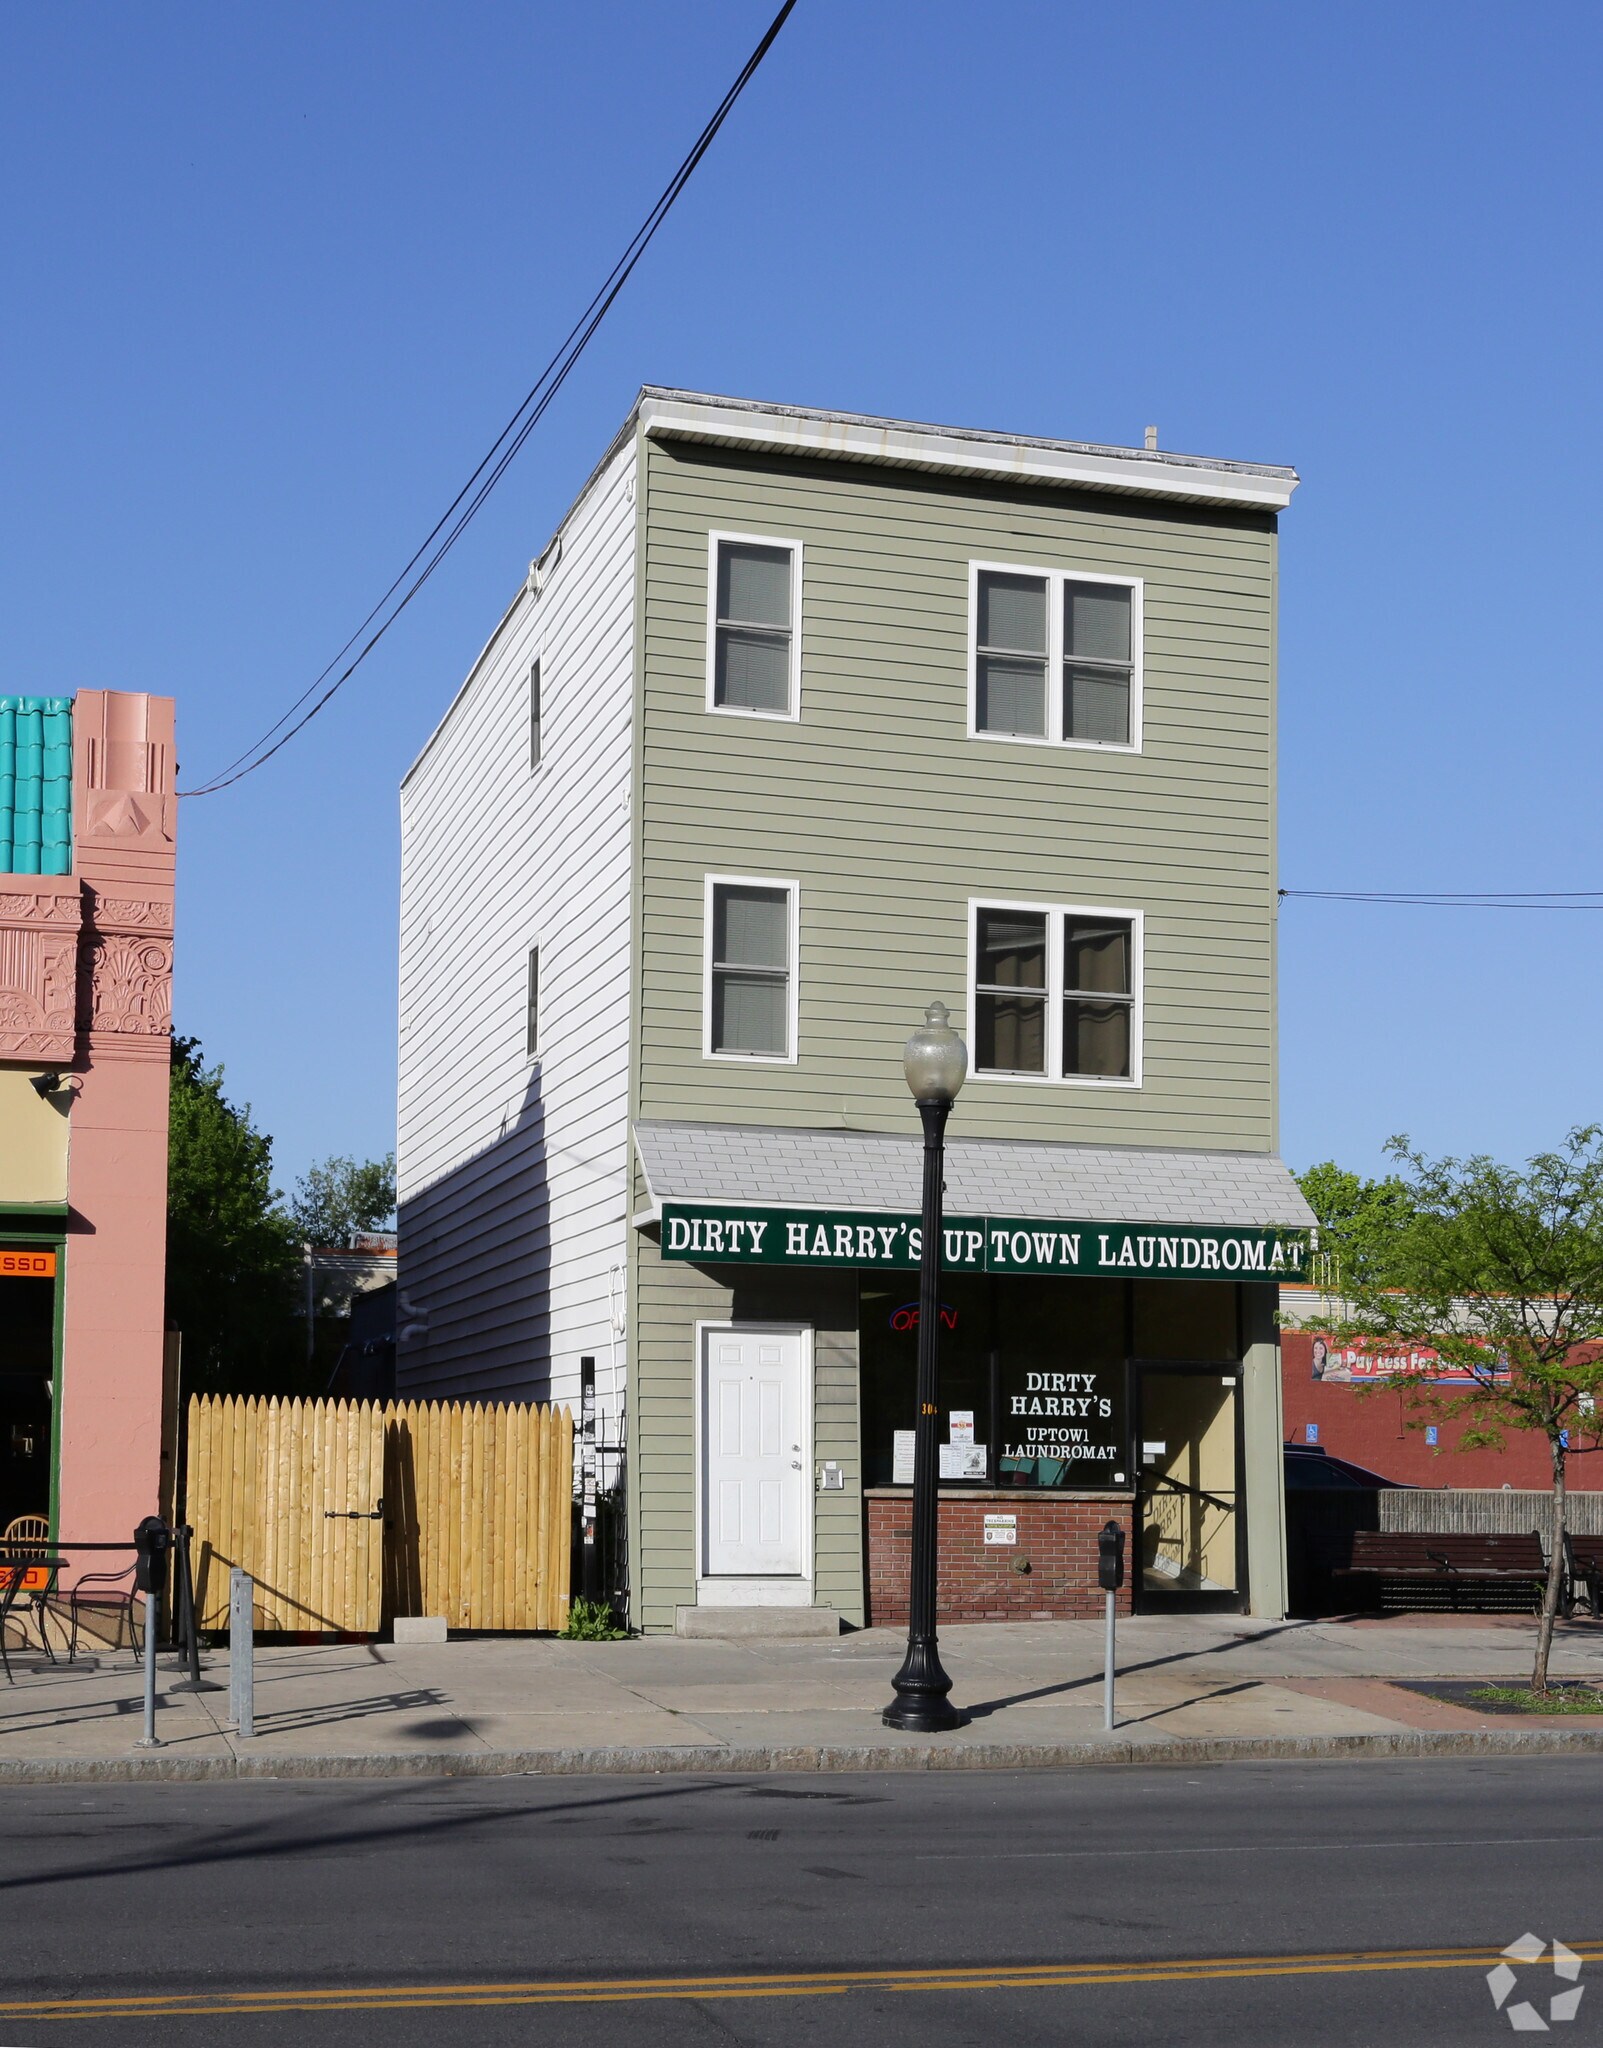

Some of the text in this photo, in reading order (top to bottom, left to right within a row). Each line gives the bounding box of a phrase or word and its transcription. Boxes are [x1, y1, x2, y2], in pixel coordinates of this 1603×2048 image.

[668, 1217, 768, 1254] DIRTY
[786, 1222, 923, 1260] HARRY'S
[1098, 1234, 1304, 1272] LAUNDROMAT
[0, 1257, 47, 1271] SSO
[893, 1310, 958, 1330] OPN
[1347, 1350, 1373, 1374] Pay
[1377, 1353, 1407, 1370] Less
[1410, 1352, 1434, 1370] For
[1026, 1372, 1096, 1392] DIRTY
[1010, 1395, 1112, 1417] HARRY'S
[1004, 1444, 1117, 1460] LAUNDROMAT
